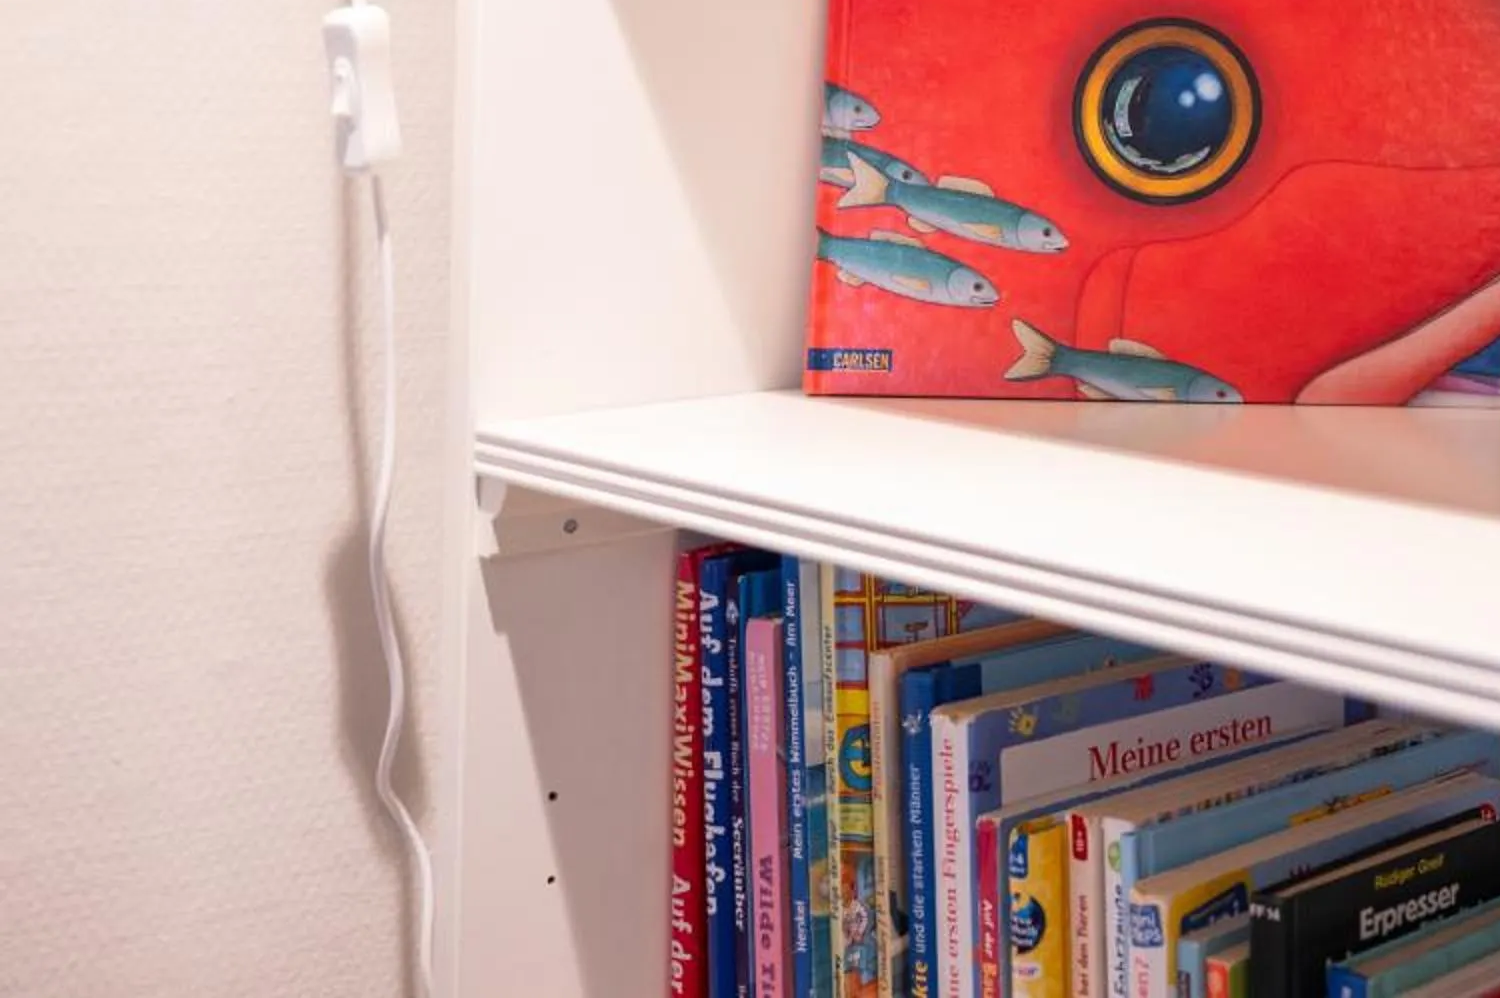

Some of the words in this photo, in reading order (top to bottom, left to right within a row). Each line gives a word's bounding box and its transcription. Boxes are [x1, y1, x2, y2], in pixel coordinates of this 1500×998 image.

[833, 350, 890, 372] CARLSEN
[698, 588, 722, 654] Auf
[784, 580, 796, 618] Meer
[786, 622, 797, 648] Am
[673, 579, 697, 848] MiniMaxiWissen
[786, 665, 801, 763] Wimmelbuch
[1088, 738, 1181, 782] Meine
[1189, 714, 1273, 757] ersten
[790, 769, 803, 818] erstes
[908, 762, 922, 825] Männer
[939, 737, 961, 881] Fingerspiele
[703, 750, 727, 916] Flughafen
[791, 823, 804, 860] Mein
[910, 829, 924, 890] starken
[732, 815, 745, 932] Seeräuber
[757, 854, 775, 950] Wilde
[671, 873, 692, 936] Auf
[794, 899, 808, 954] Henkel
[911, 895, 925, 921] die
[943, 887, 960, 959] ersten
[1076, 895, 1089, 938] Tieren
[1359, 882, 1460, 941] Erpresser
[669, 940, 693, 996] der
[912, 924, 927, 954] und
[1078, 943, 1088, 970] den
[911, 962, 929, 998] kie
